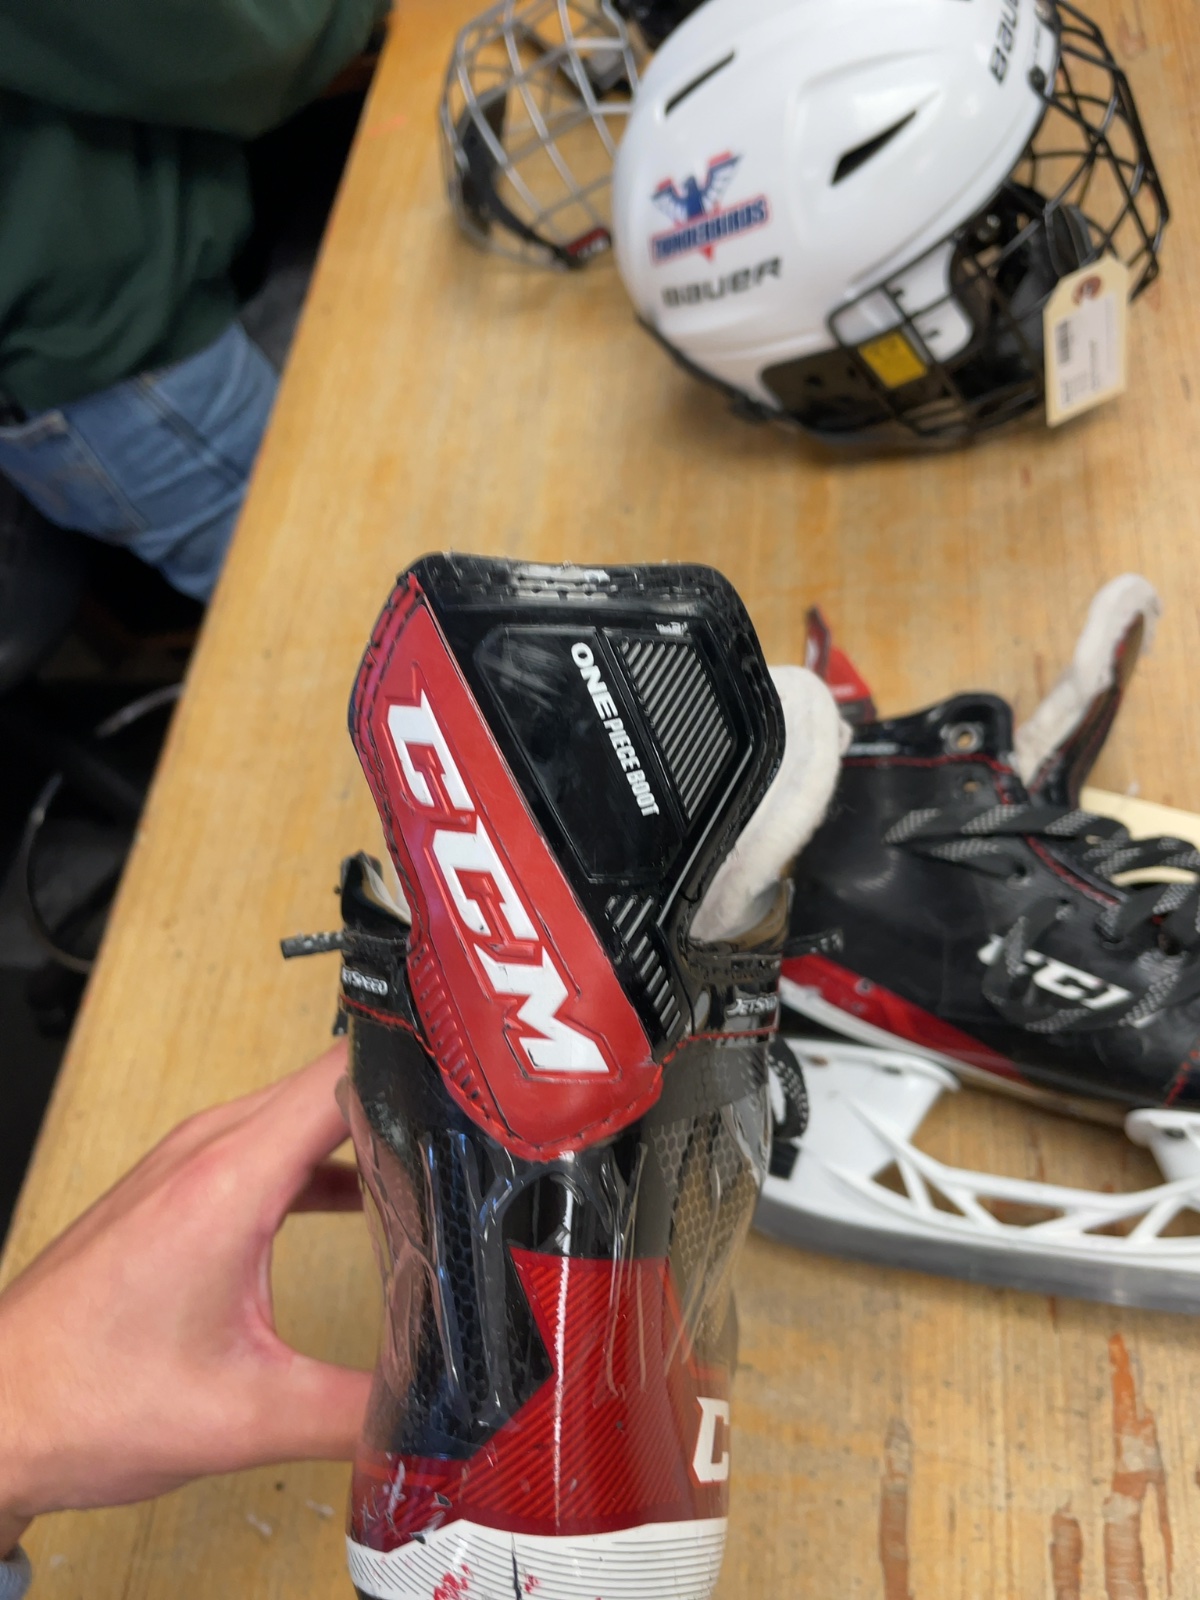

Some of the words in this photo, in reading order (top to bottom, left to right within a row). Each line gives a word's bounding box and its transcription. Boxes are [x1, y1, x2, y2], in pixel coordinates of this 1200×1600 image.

[662, 255, 782, 308] BAUER
[571, 642, 619, 720] ONE
[603, 717, 641, 772] PIECE
[626, 769, 660, 816] BOOT
[387, 688, 610, 1073] CCM
